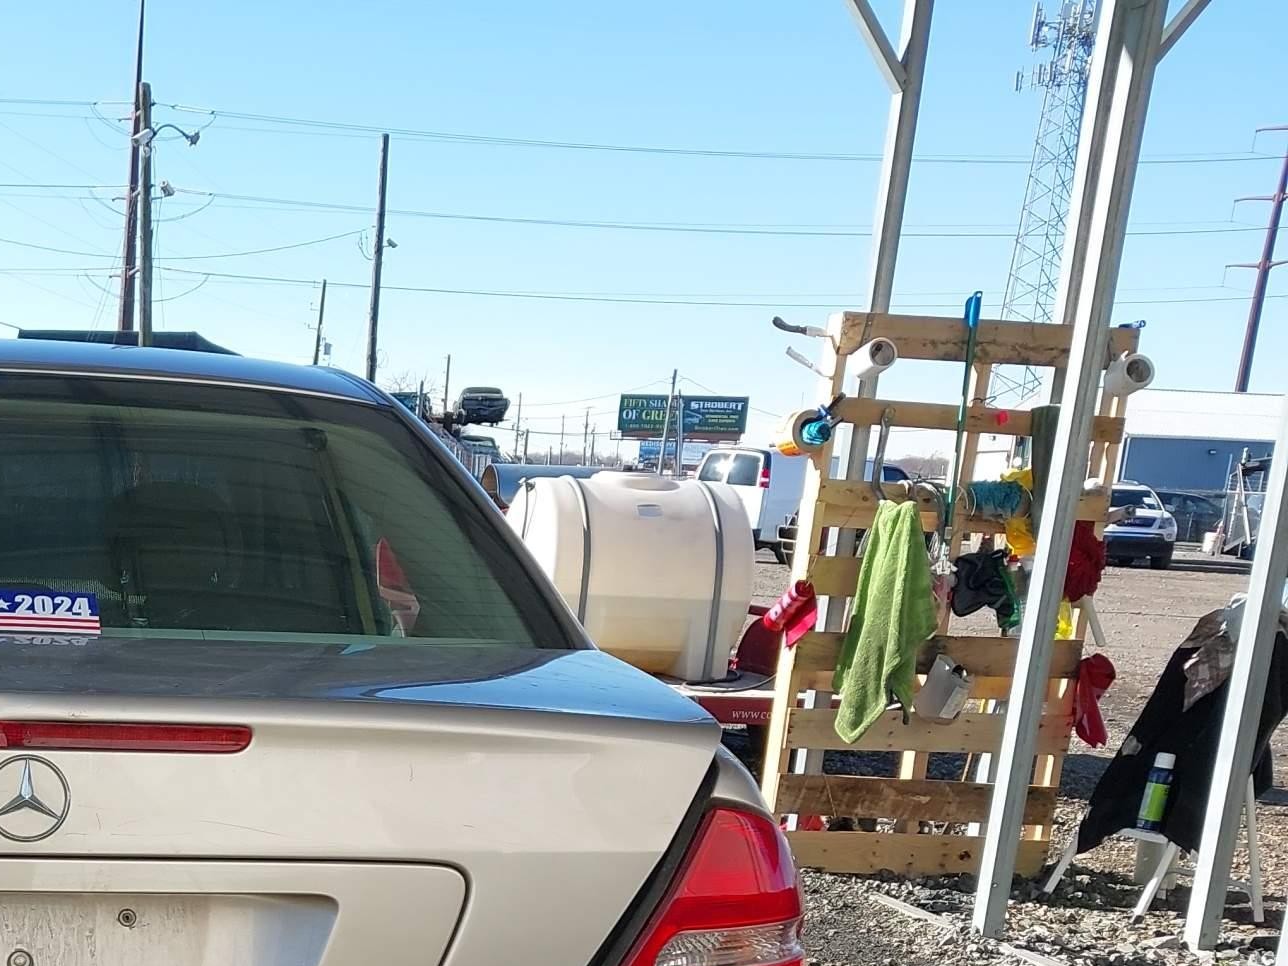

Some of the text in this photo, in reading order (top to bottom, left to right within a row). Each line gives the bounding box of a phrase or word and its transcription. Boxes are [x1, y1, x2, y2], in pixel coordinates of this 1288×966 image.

[624, 399, 647, 408] FIFTY
[622, 408, 641, 421] OF
[14, 594, 91, 616] 2024
